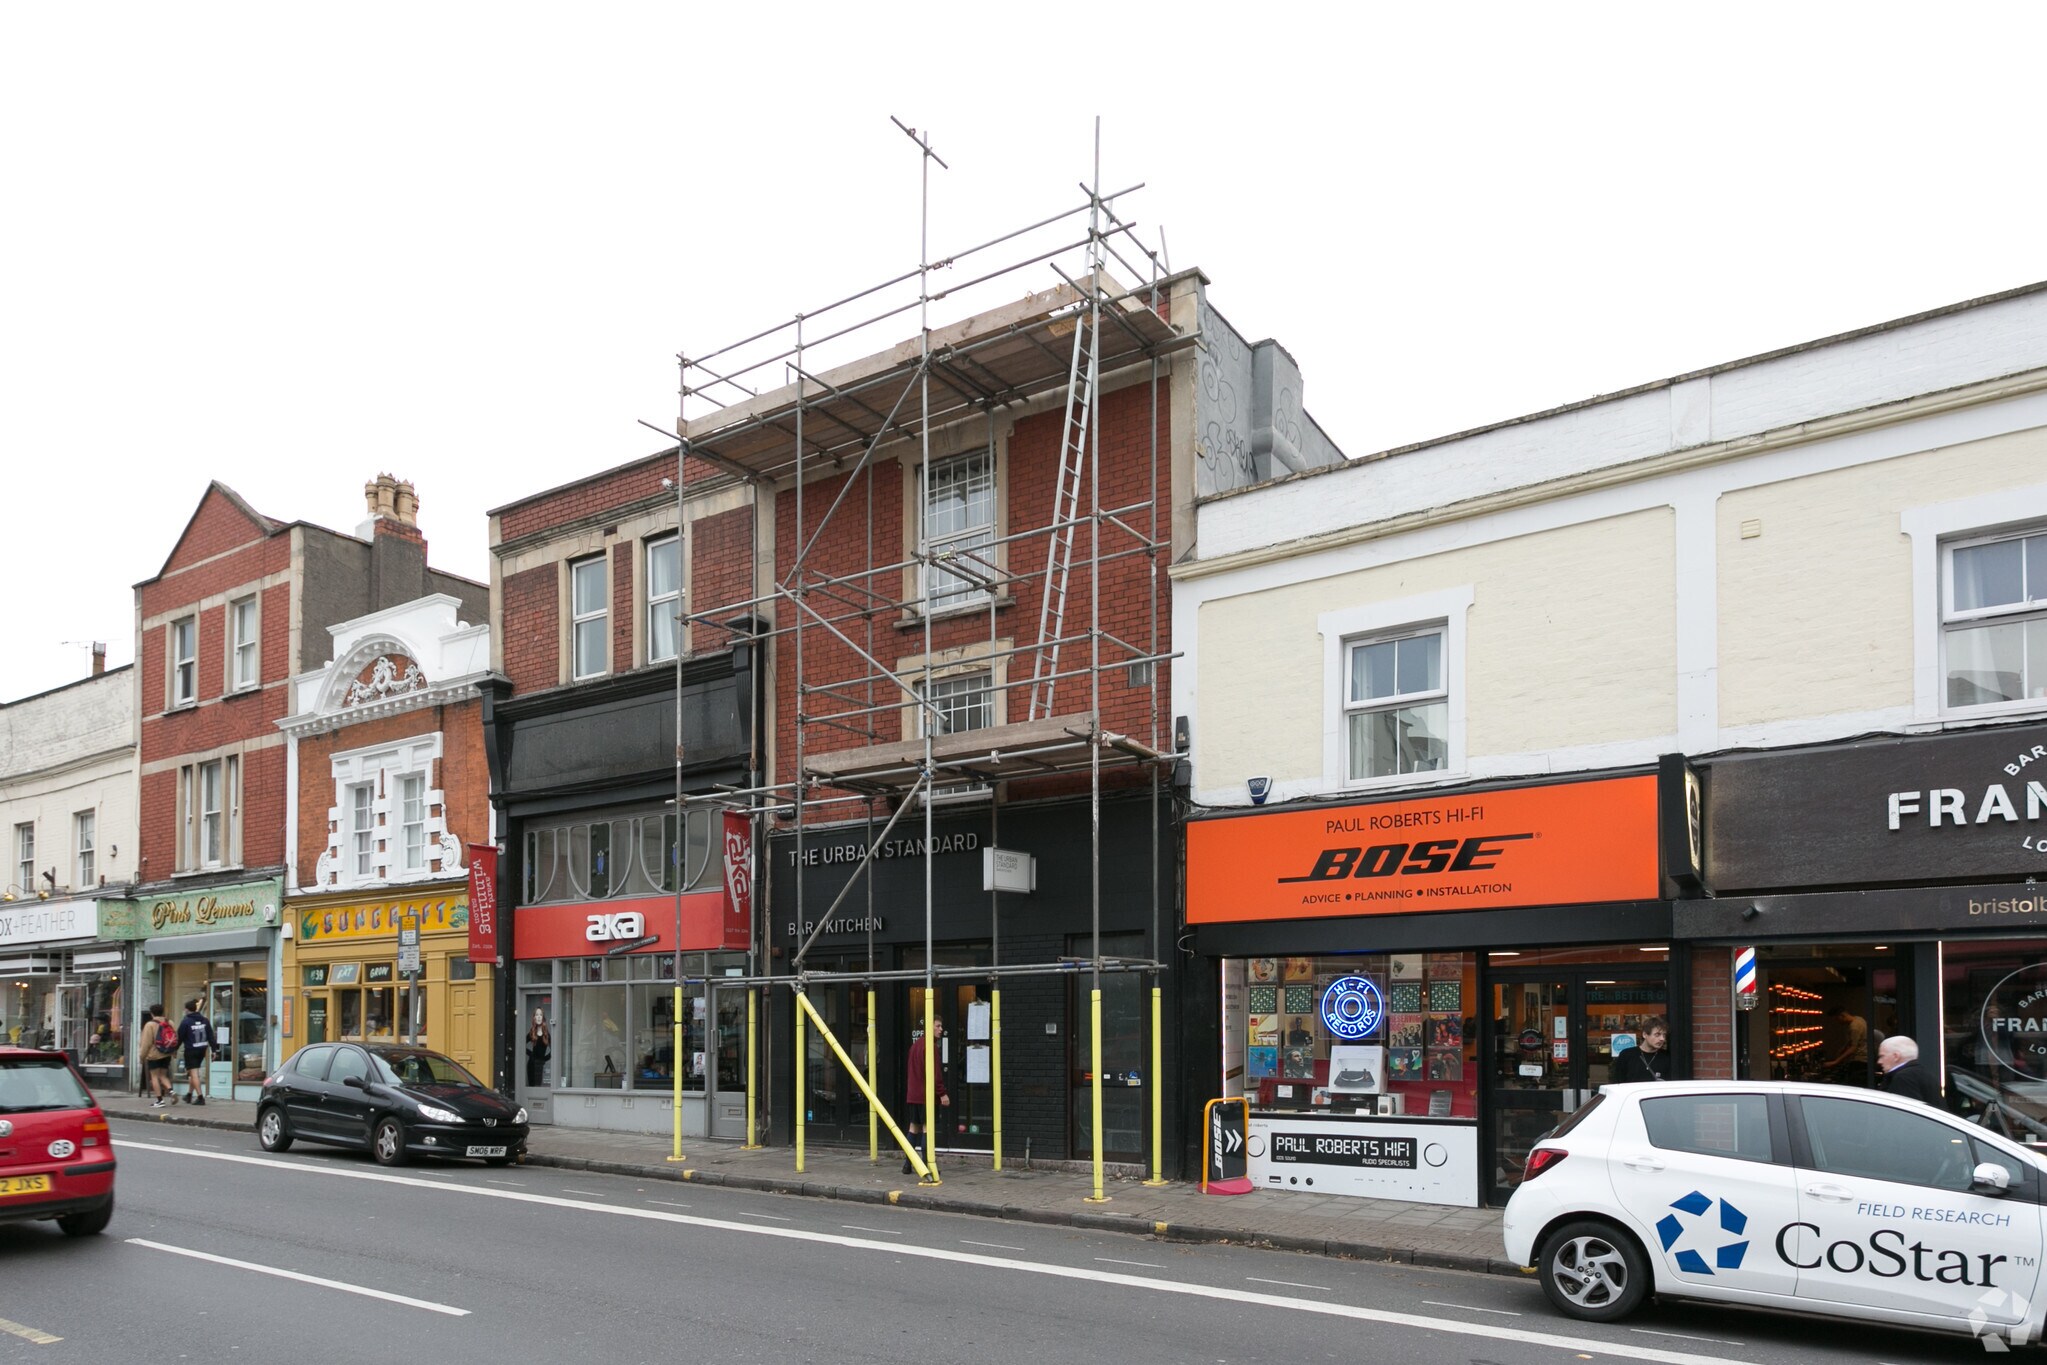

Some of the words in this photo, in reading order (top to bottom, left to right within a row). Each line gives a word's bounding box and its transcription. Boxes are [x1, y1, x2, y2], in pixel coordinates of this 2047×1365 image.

[1326, 817, 1365, 834] PAUL
[1370, 810, 1441, 830] ROBERTS
[1446, 806, 1484, 823] HI-FI
[789, 849, 819, 867] THE
[884, 833, 978, 859] STANDARD
[1278, 832, 1534, 883] BOSE
[472, 858, 492, 934] winning
[1302, 893, 1341, 905] ADVICE
[1354, 889, 1413, 902] PLANNING
[1426, 883, 1512, 897] INSTALLATION
[152, 900, 191, 929] Pink
[195, 896, 255, 925] Lemons
[825, 917, 883, 934] KITCHEN
[586, 911, 645, 942] aka
[1333, 981, 1370, 995] HI-FI
[2018, 989, 2047, 1008] BAR
[1327, 1008, 1376, 1034] RECORDS
[1213, 1105, 1224, 1179] BOSE
[1276, 1136, 1311, 1153] PAUL
[1315, 1138, 1379, 1156] ROBERTS
[1384, 1141, 1410, 1157] HIFI
[1362, 1158, 1377, 1166] AUDIO
[1378, 1159, 1410, 1167] SPECIALISTS
[15, 1177, 44, 1191] JXS
[1857, 1202, 1906, 1218] FIELD
[1911, 1207, 2011, 1227] RESEARCH
[1775, 1222, 2008, 1288] CoStar
